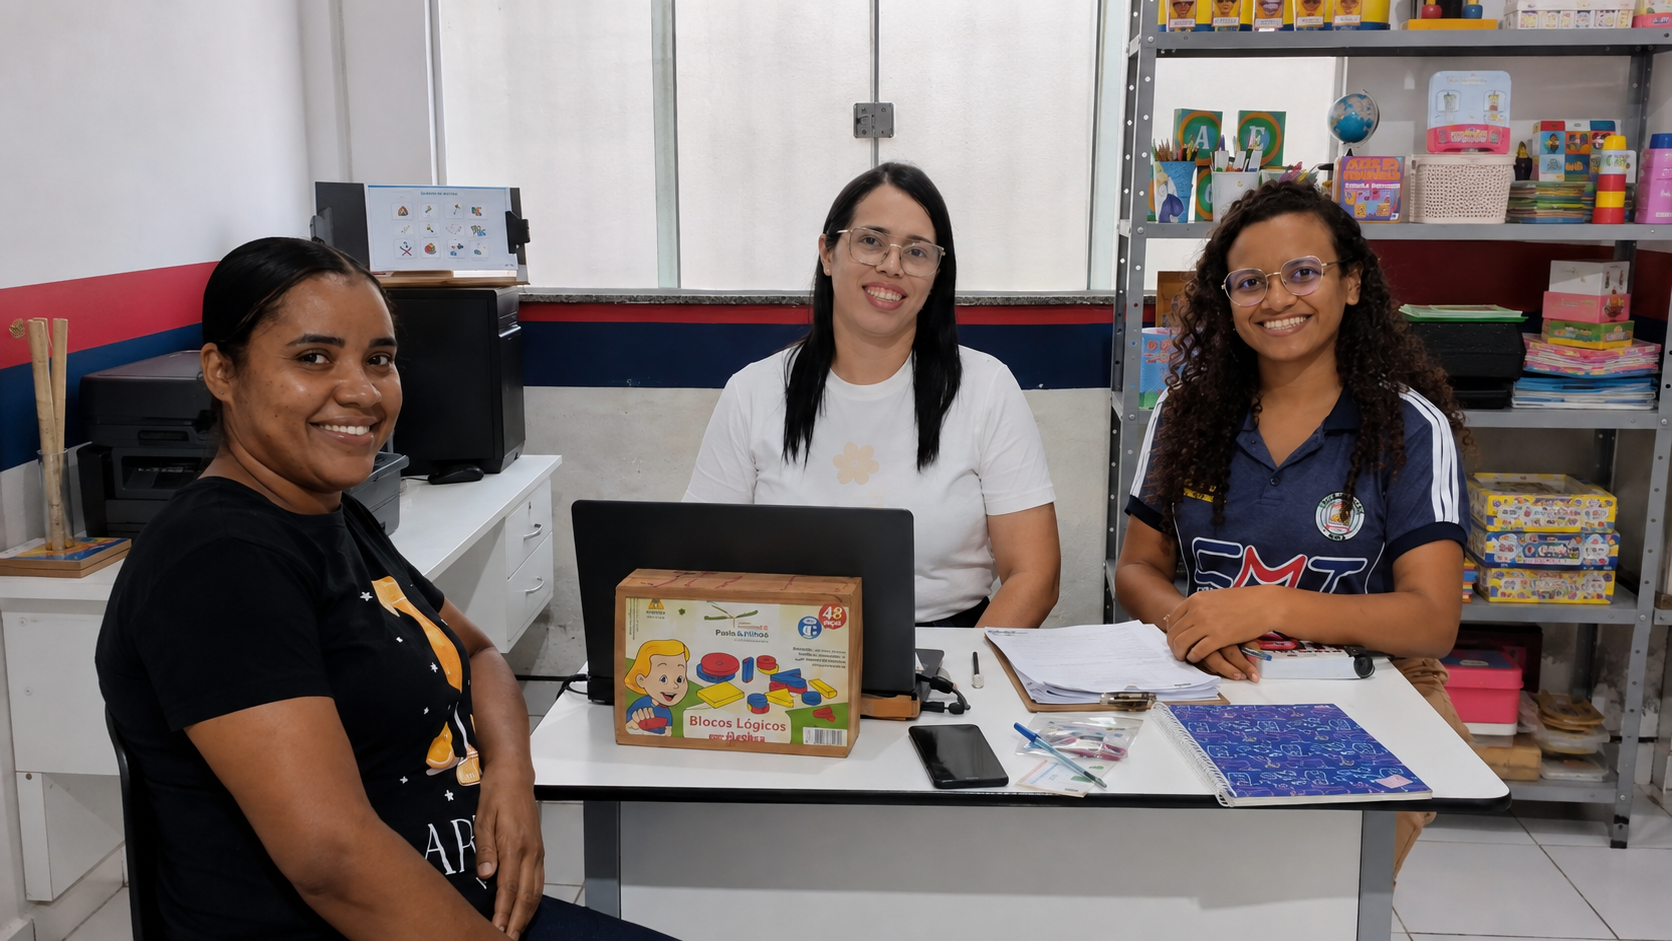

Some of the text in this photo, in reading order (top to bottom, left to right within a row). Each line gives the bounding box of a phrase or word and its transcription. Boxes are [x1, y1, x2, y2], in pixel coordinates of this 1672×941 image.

[1194, 125, 1210, 149] A
[1248, 125, 1265, 150] E
[822, 606, 843, 620] 48
[689, 715, 787, 733] Blocos Lógicos
[425, 814, 477, 875] AR
